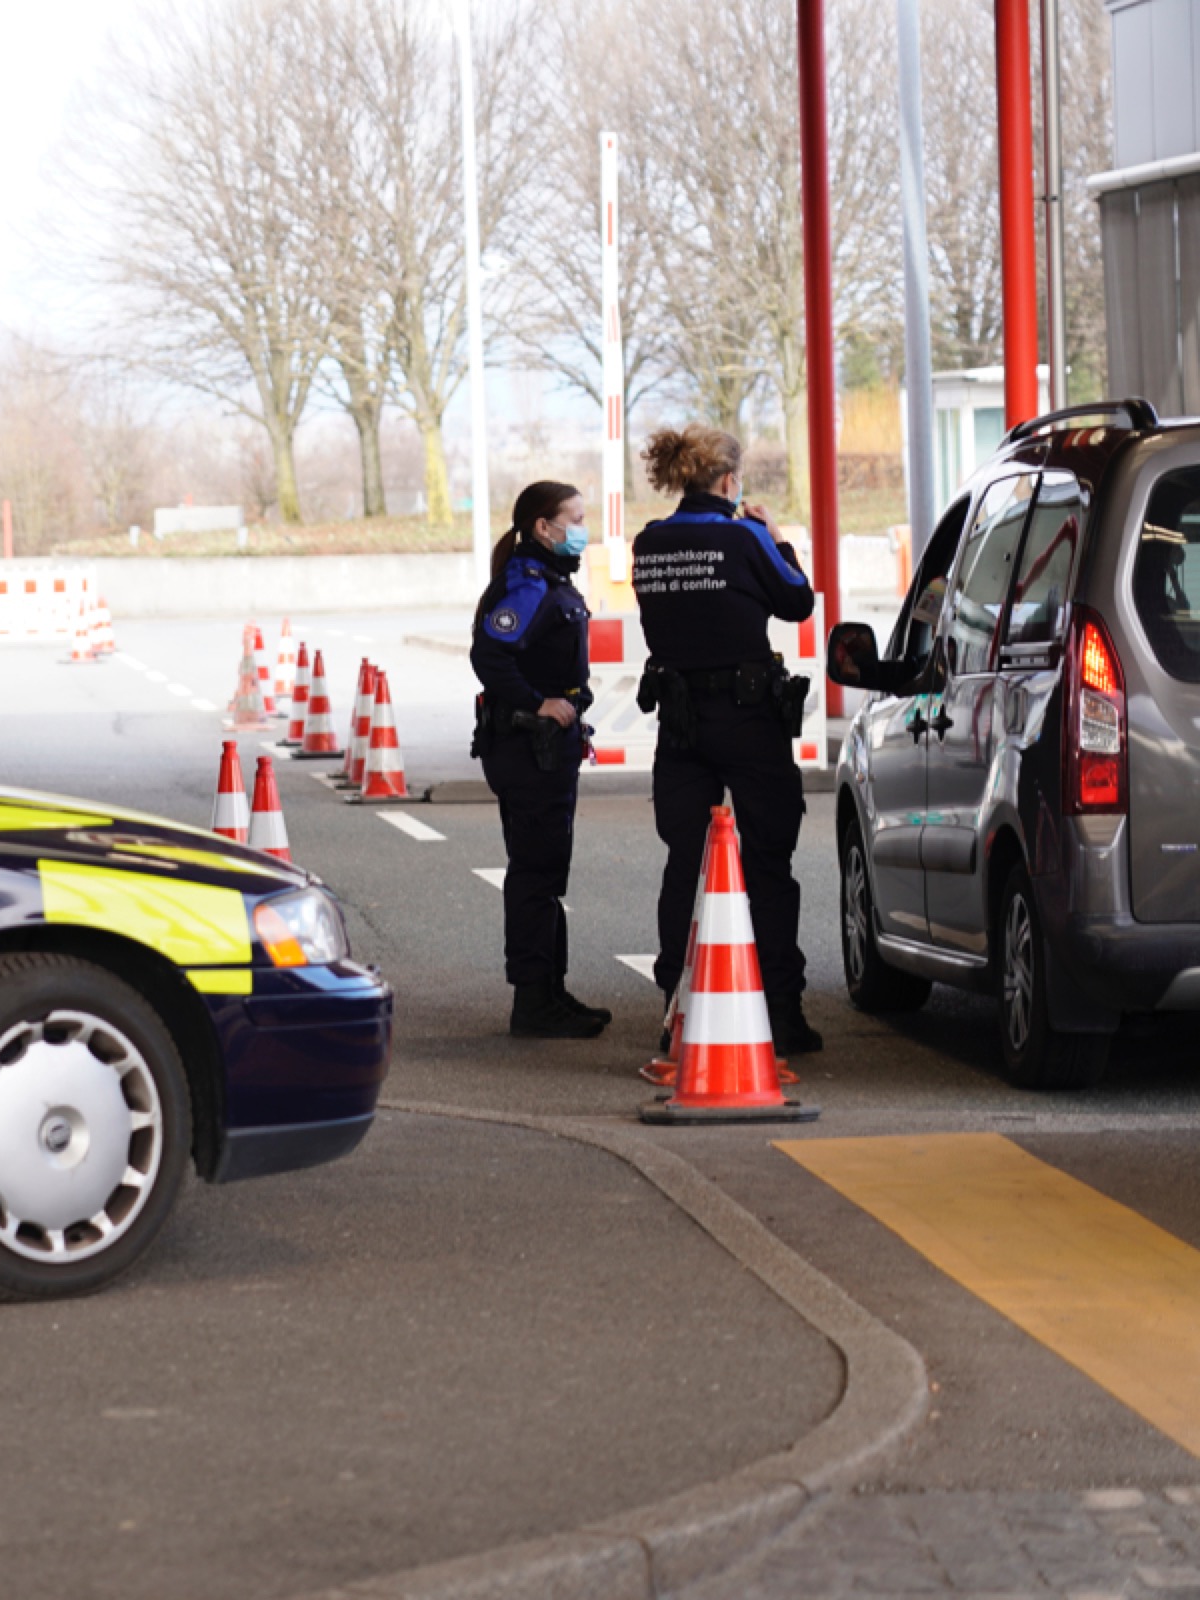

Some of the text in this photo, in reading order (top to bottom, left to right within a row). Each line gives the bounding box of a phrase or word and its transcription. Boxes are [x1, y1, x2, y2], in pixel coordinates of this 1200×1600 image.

[636, 549, 724, 563] renzwachtkorps
[669, 580, 680, 592] di
[682, 577, 727, 591] confine
